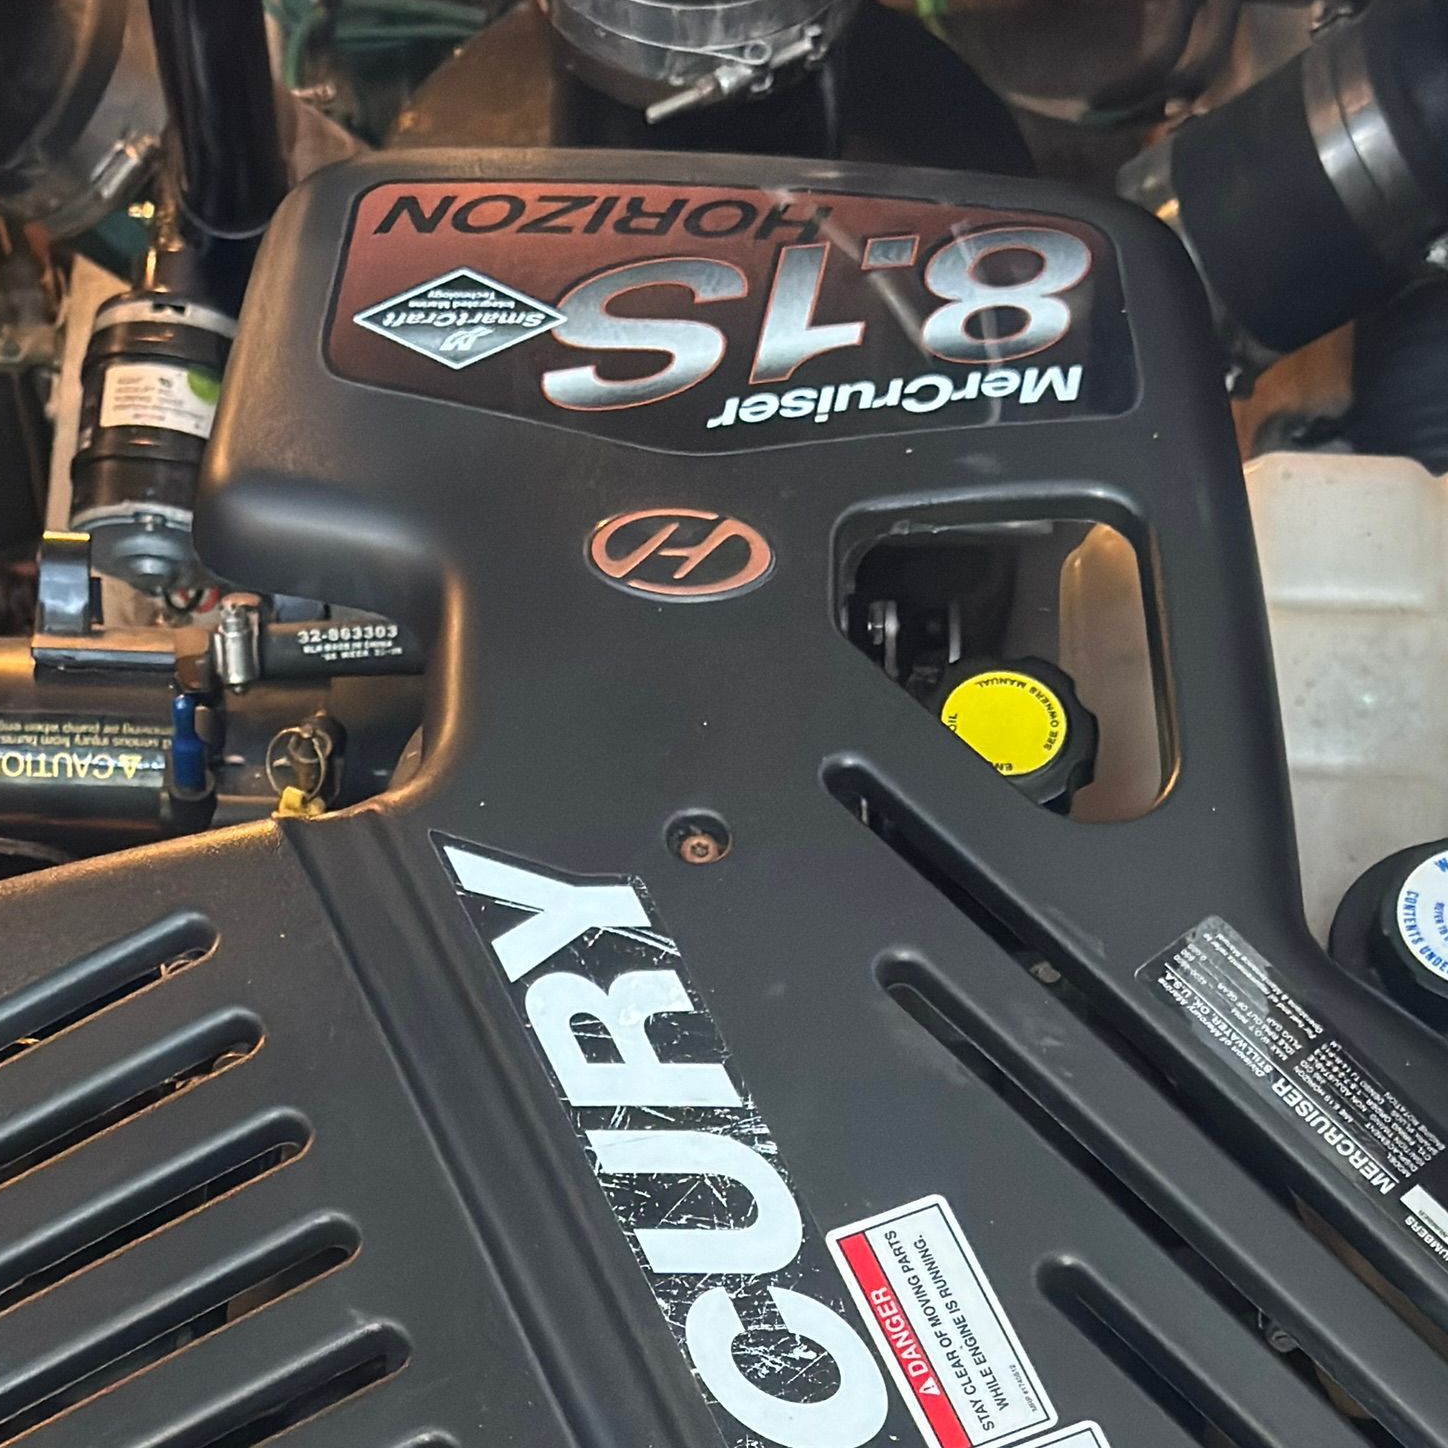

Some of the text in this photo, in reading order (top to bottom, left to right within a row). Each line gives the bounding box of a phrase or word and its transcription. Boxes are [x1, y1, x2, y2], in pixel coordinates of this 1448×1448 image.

[372, 193, 830, 244] HORIZON
[382, 312, 545, 326] SmartCraft
[408, 299, 514, 308] Integrated Marine
[427, 290, 495, 299] Technology
[539, 225, 1091, 411] 8.1S
[706, 363, 1081, 430] MerCruiser
[974, 677, 1026, 687] MANUAL
[1042, 730, 1058, 750] SEE
[1403, 890, 1424, 944] CONTENTS
[1156, 976, 1265, 1078] Division of Mercury Marine
[1269, 1075, 1397, 1196] MERCRUISER
[869, 1282, 929, 1380] DANGER
[883, 1227, 995, 1432] STAY CLEAR OF MOVING PARTS
[911, 1232, 1010, 1411] WHILE ENGINE IS RUNNING.
